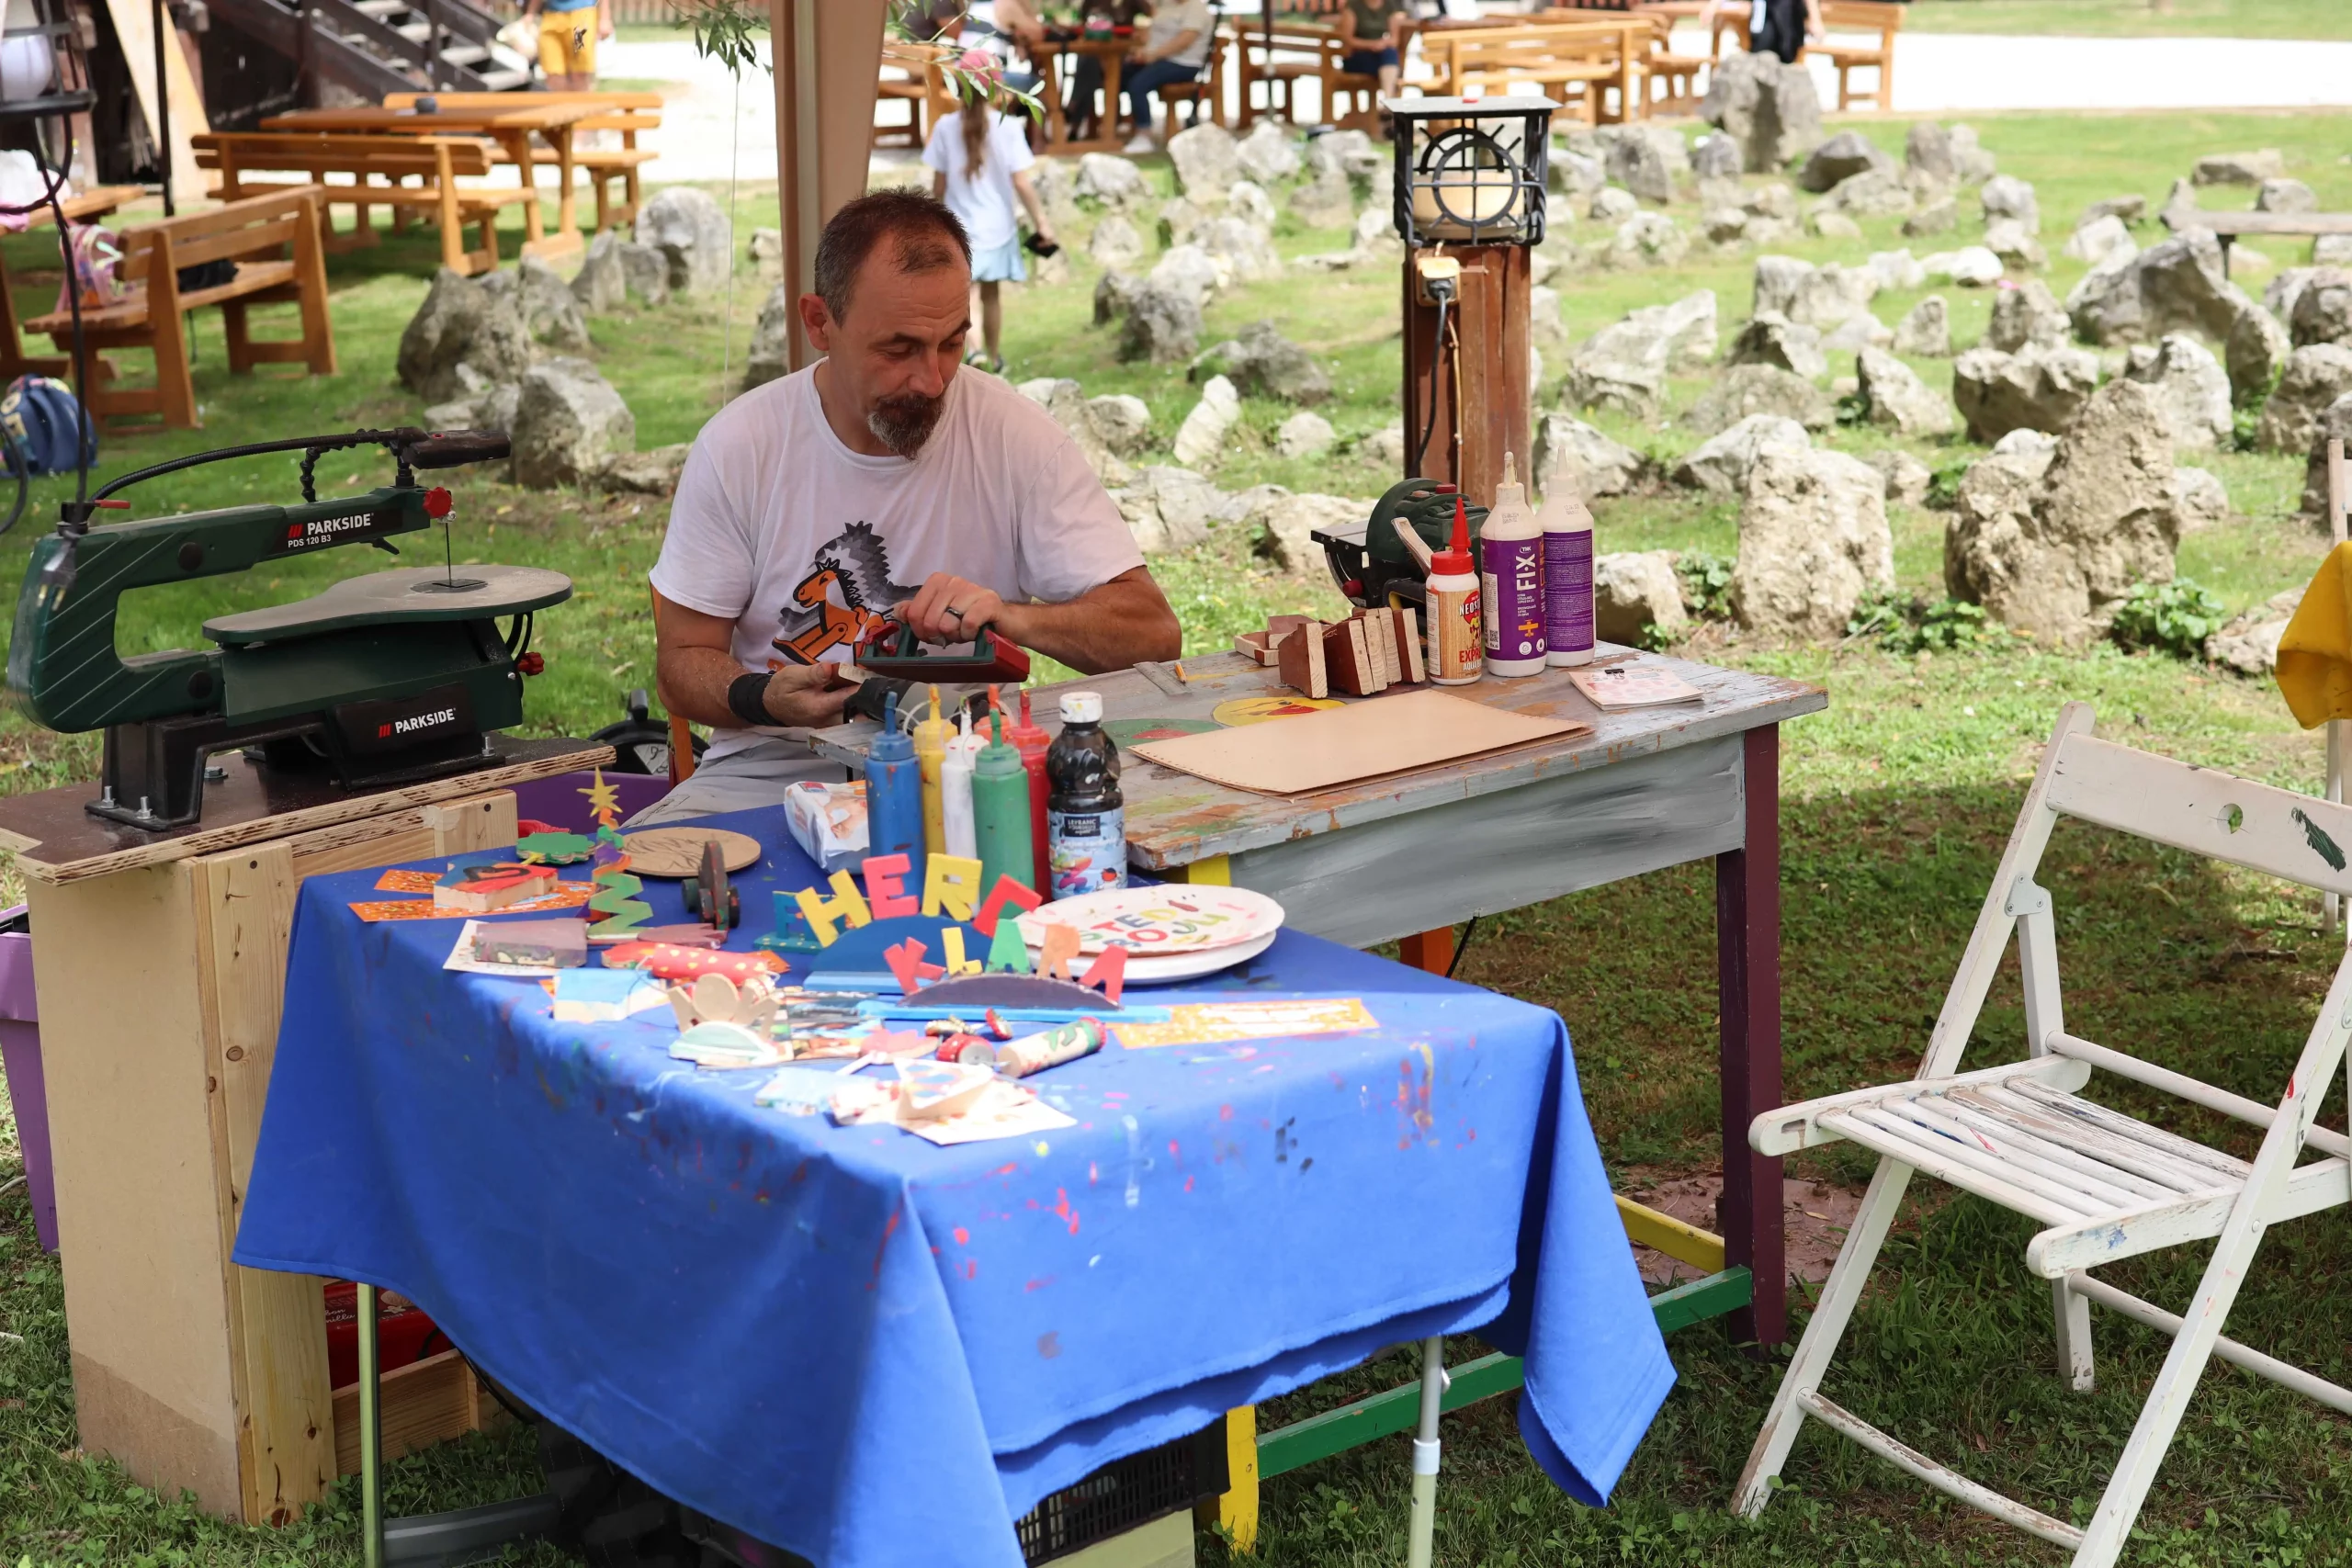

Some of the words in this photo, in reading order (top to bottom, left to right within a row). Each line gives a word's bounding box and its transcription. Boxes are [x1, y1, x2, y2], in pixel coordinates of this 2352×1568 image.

[307, 513, 371, 536] PARKSIDE
[288, 539, 304, 547] PDS
[306, 536, 319, 545] 120
[321, 535, 332, 543] B3
[395, 708, 455, 734] PARKSIDE
[883, 919, 1129, 1003] KLARA
